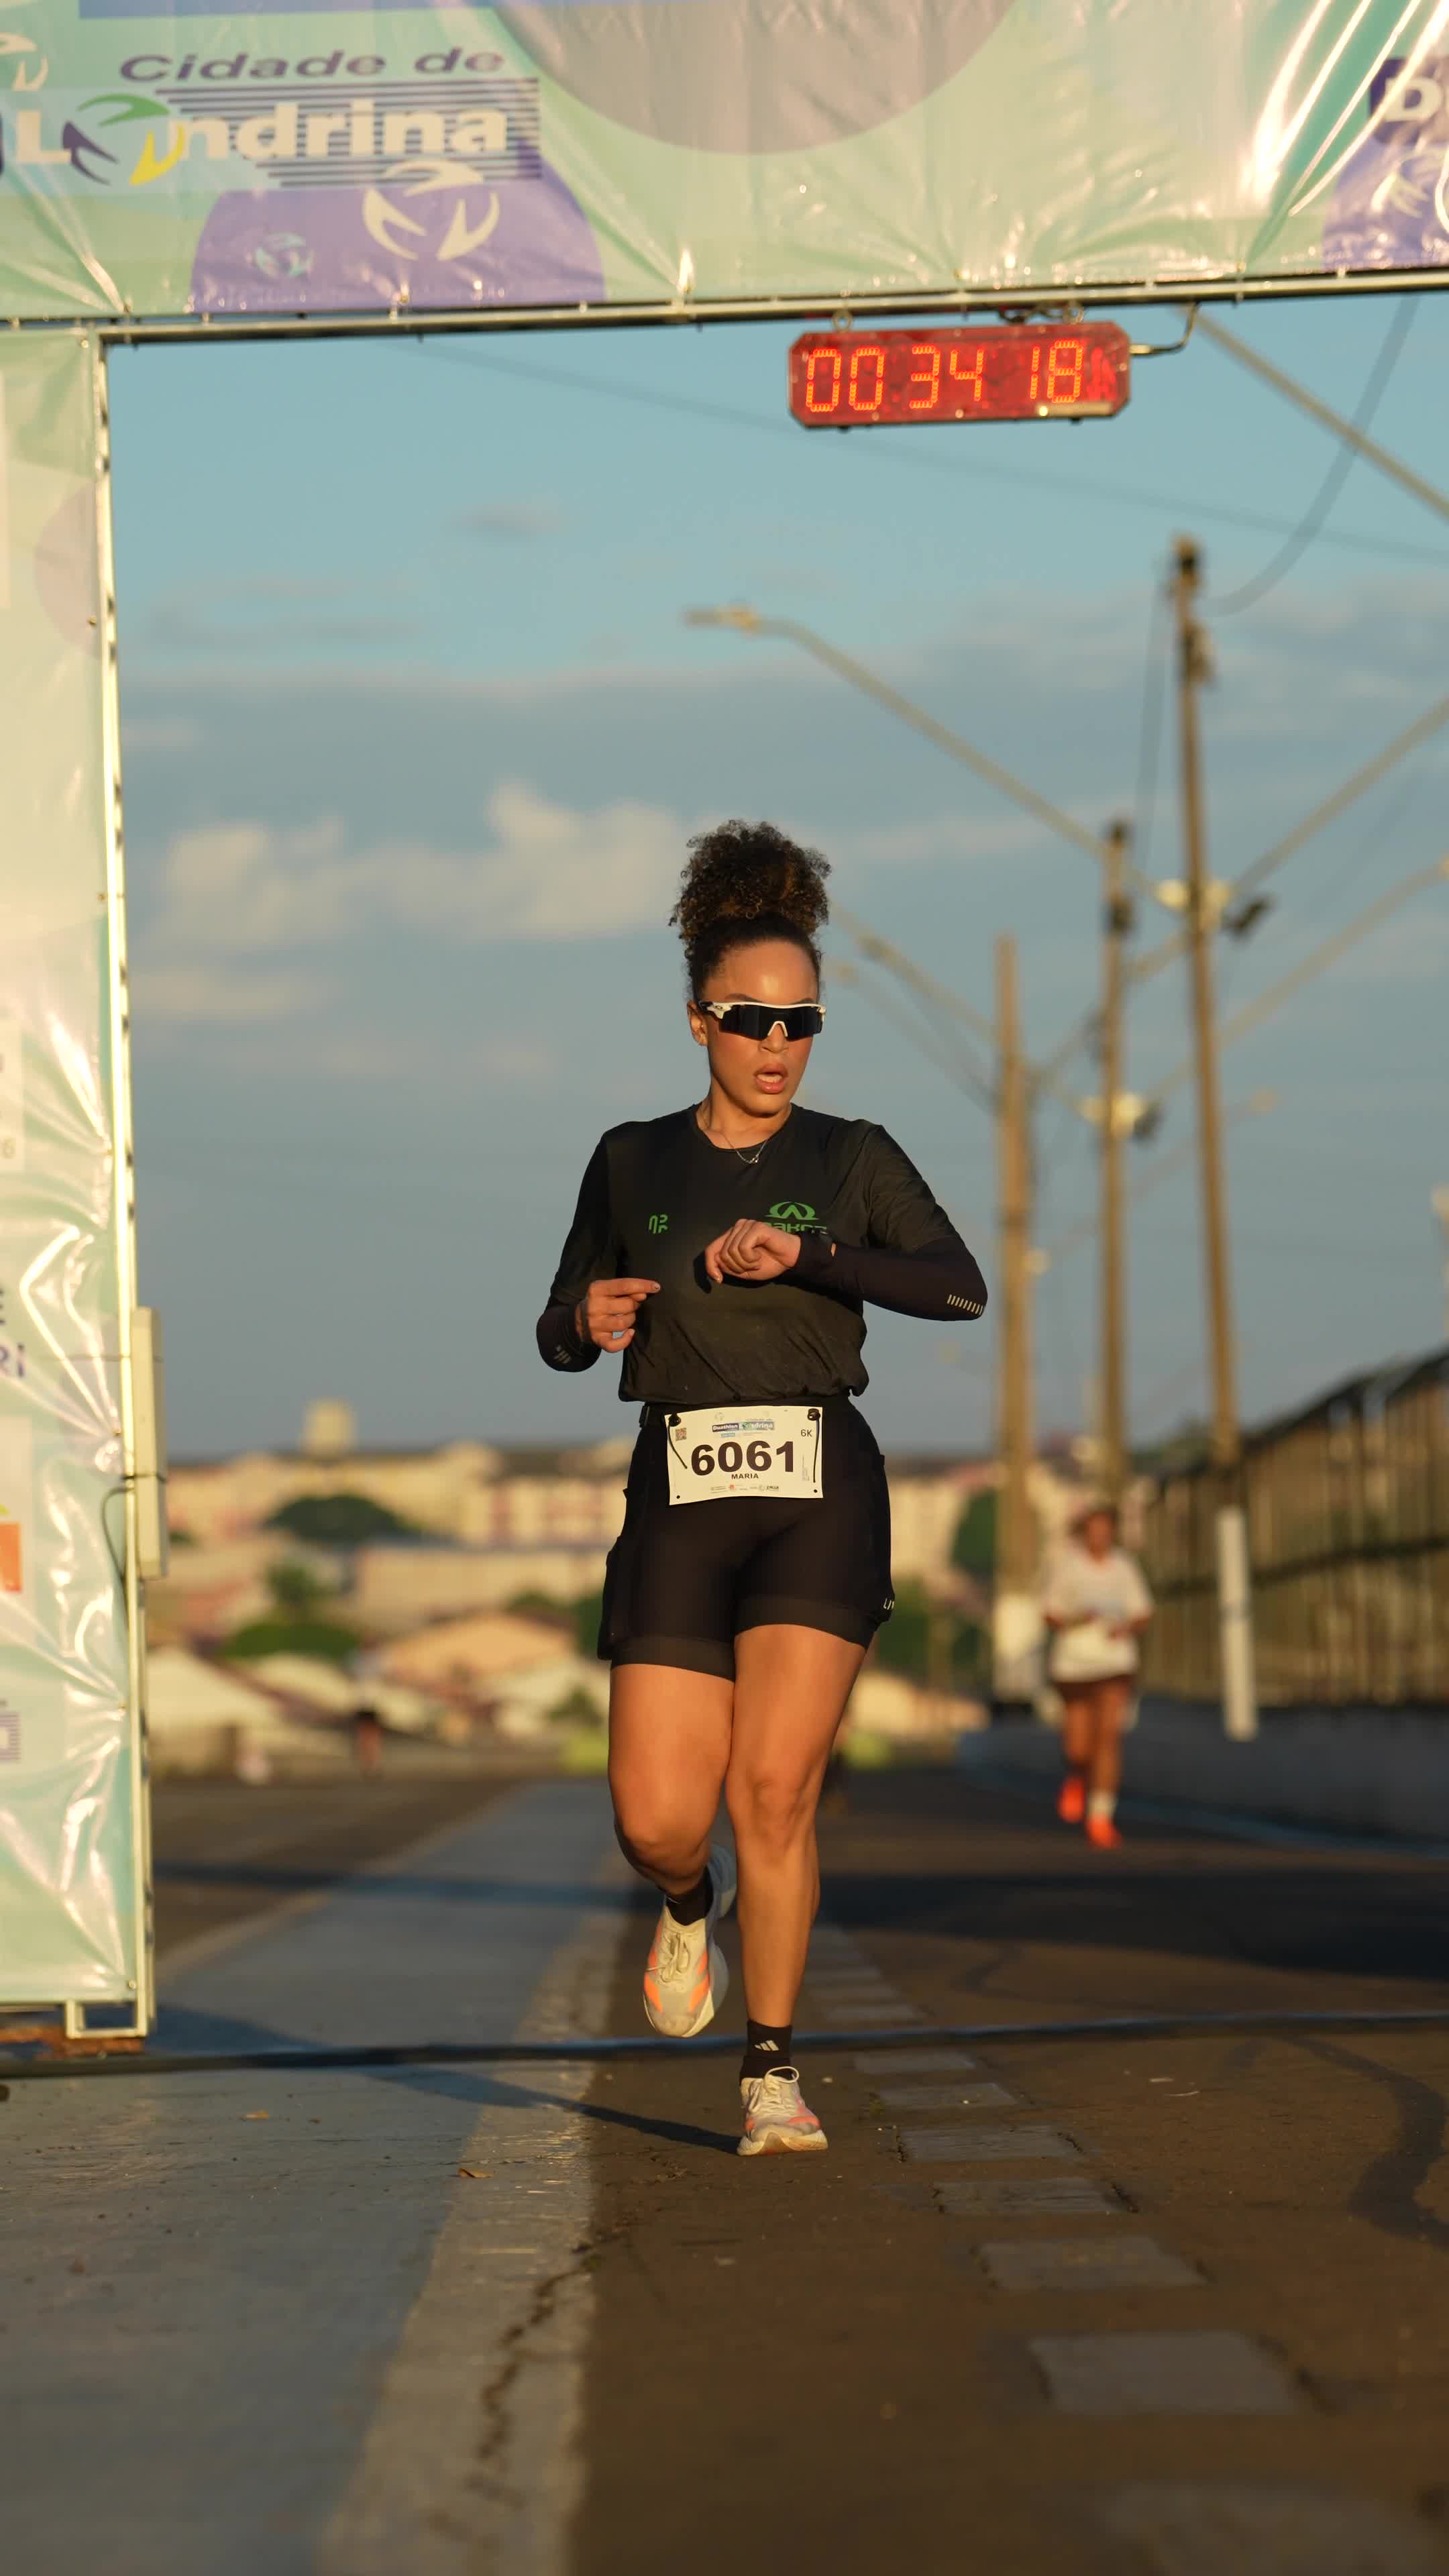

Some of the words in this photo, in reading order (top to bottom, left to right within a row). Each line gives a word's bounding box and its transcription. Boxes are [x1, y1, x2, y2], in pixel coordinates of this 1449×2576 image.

[120, 50, 386, 82] Cidade
[414, 47, 504, 74] de
[805, 345, 885, 412] 00
[910, 344, 984, 409] 34
[1030, 339, 1083, 405] 18
[800, 1429, 813, 1438] 6K
[691, 1440, 794, 1476] 6061
